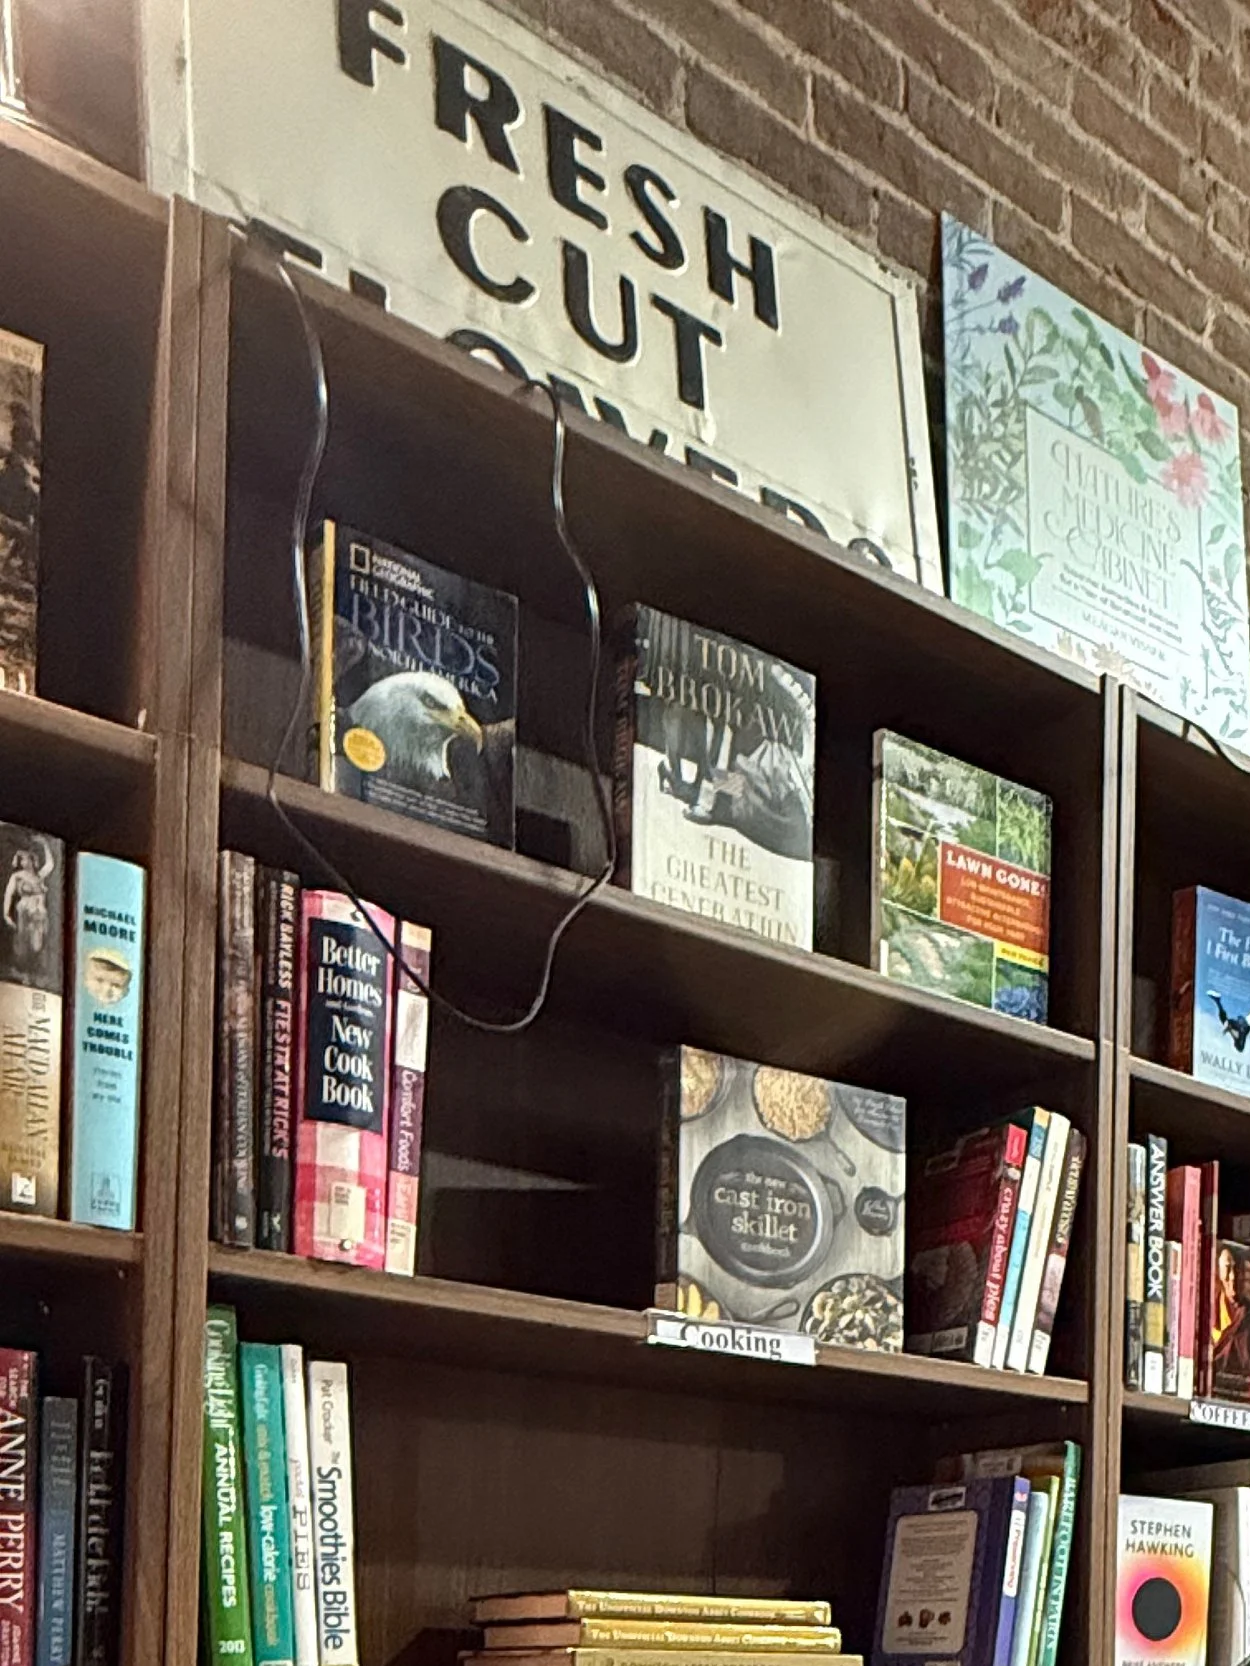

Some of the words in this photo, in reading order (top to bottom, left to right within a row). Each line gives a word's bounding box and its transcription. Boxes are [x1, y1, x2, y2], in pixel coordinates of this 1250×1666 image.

[338, 0, 780, 333] FRESH
[436, 184, 723, 411] CUT
[351, 593, 500, 690] BIRDS
[697, 635, 765, 693] TOM
[656, 666, 799, 746] BROKAW
[706, 834, 751, 873] THE
[946, 849, 993, 881] LAWN
[666, 854, 786, 912] GREATEST
[83, 919, 137, 944] MOORE
[84, 904, 138, 927] MICHAEL
[650, 882, 798, 944] GENERATION
[321, 935, 381, 977] Better
[317, 966, 383, 1007] Homes
[86, 1026, 130, 1045] COMES
[93, 1011, 124, 1028] HERE
[331, 1014, 374, 1050] New
[82, 1041, 134, 1062] TROUBLE
[324, 1045, 374, 1082] Cook
[1200, 1048, 1244, 1078] WALLY
[322, 1075, 374, 1113] Book
[400, 1069, 418, 1128] Comfort
[396, 1128, 415, 1172] Foods
[713, 1185, 762, 1209] cast
[766, 1193, 812, 1221] iron
[993, 1186, 1013, 1233] crazy
[1147, 1142, 1167, 1234] ANSWER
[730, 1211, 800, 1244] skillet
[1146, 1235, 1166, 1299] BOOK
[679, 1324, 784, 1359] Cooking
[321, 1378, 334, 1399] Pat
[0, 1406, 27, 1502] ANNE
[215, 1442, 238, 1527] ANNUAL
[292, 1504, 311, 1591] PIES
[316, 1465, 348, 1587] Smoothies
[1129, 1518, 1192, 1539] STEPHEN
[0, 1512, 26, 1615] PERRY
[218, 1531, 238, 1609] RECIPES
[1125, 1538, 1195, 1559] HAWKING
[322, 1590, 351, 1650] Bible
